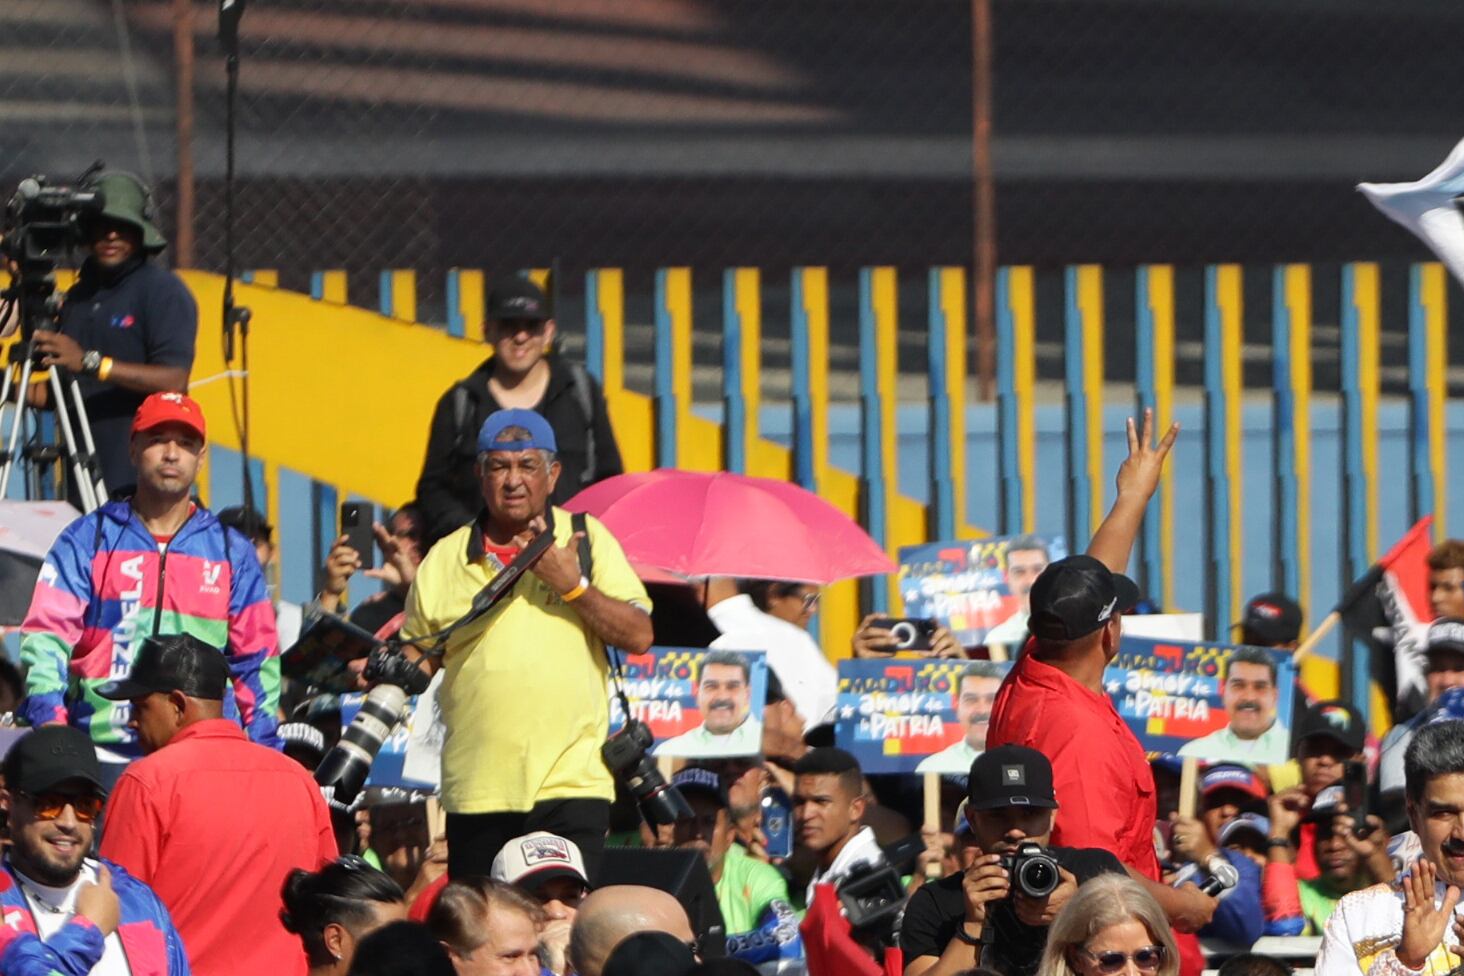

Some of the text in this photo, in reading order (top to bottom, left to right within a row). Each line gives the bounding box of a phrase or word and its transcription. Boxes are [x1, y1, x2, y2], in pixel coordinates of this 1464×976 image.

[1125, 670, 1212, 696] amor de
[859, 692, 945, 714] amor de
[1135, 689, 1210, 721] PATRIA
[869, 712, 944, 740] PATRIA
